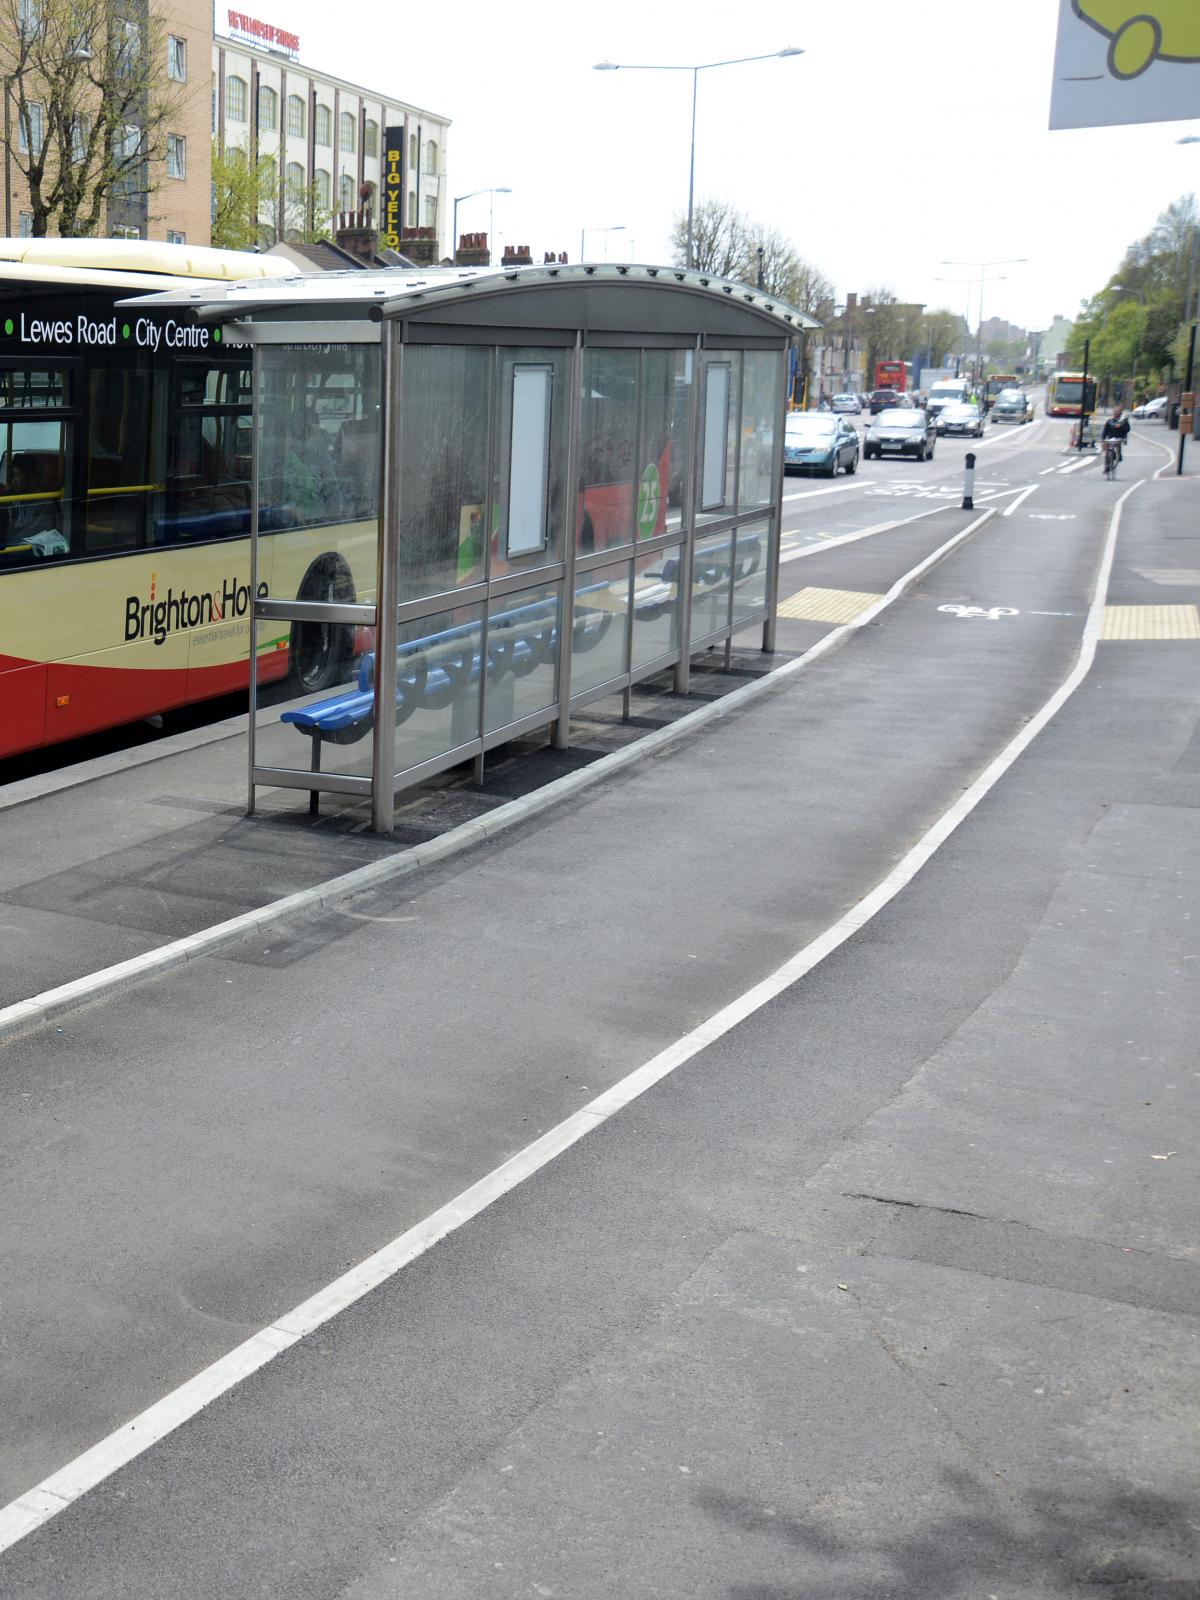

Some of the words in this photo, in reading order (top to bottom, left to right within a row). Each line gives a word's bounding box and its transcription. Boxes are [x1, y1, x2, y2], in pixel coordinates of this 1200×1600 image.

[387, 150, 400, 184] BIG
[21, 312, 73, 344] Lewes
[77, 313, 116, 345] Road
[135, 318, 161, 352] City
[165, 320, 209, 348] Centre
[640, 481, 658, 522] 25
